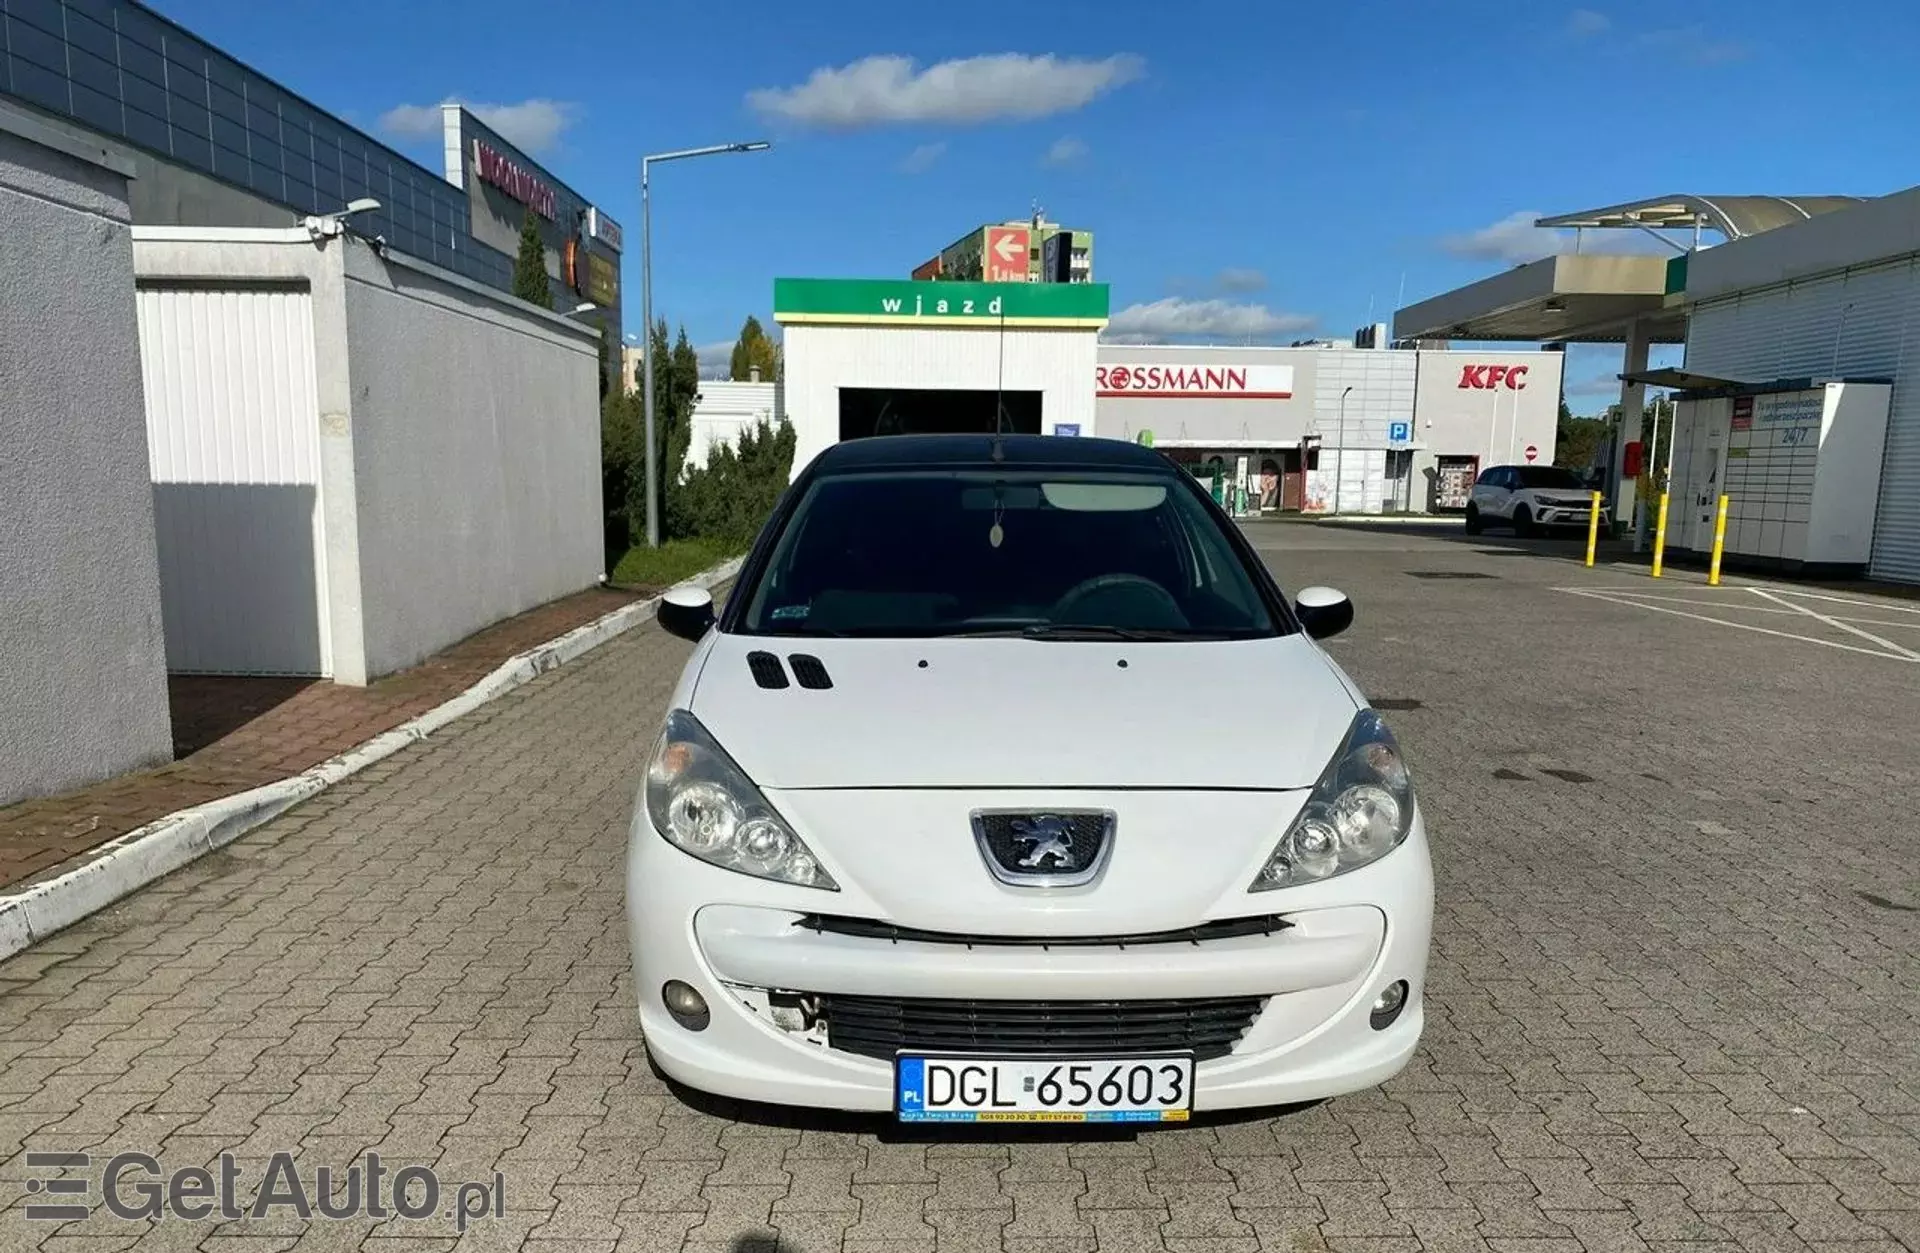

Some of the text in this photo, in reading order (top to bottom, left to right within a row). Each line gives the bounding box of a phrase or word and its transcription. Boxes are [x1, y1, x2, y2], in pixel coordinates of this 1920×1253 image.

[882, 295, 1001, 317] wjazd
[1096, 367, 1246, 390] ROSSMANN
[1458, 365, 1528, 390] KFC
[1393, 424, 1405, 439] P
[928, 1064, 1183, 1106] DGL 65603
[904, 1090, 920, 1103] PL
